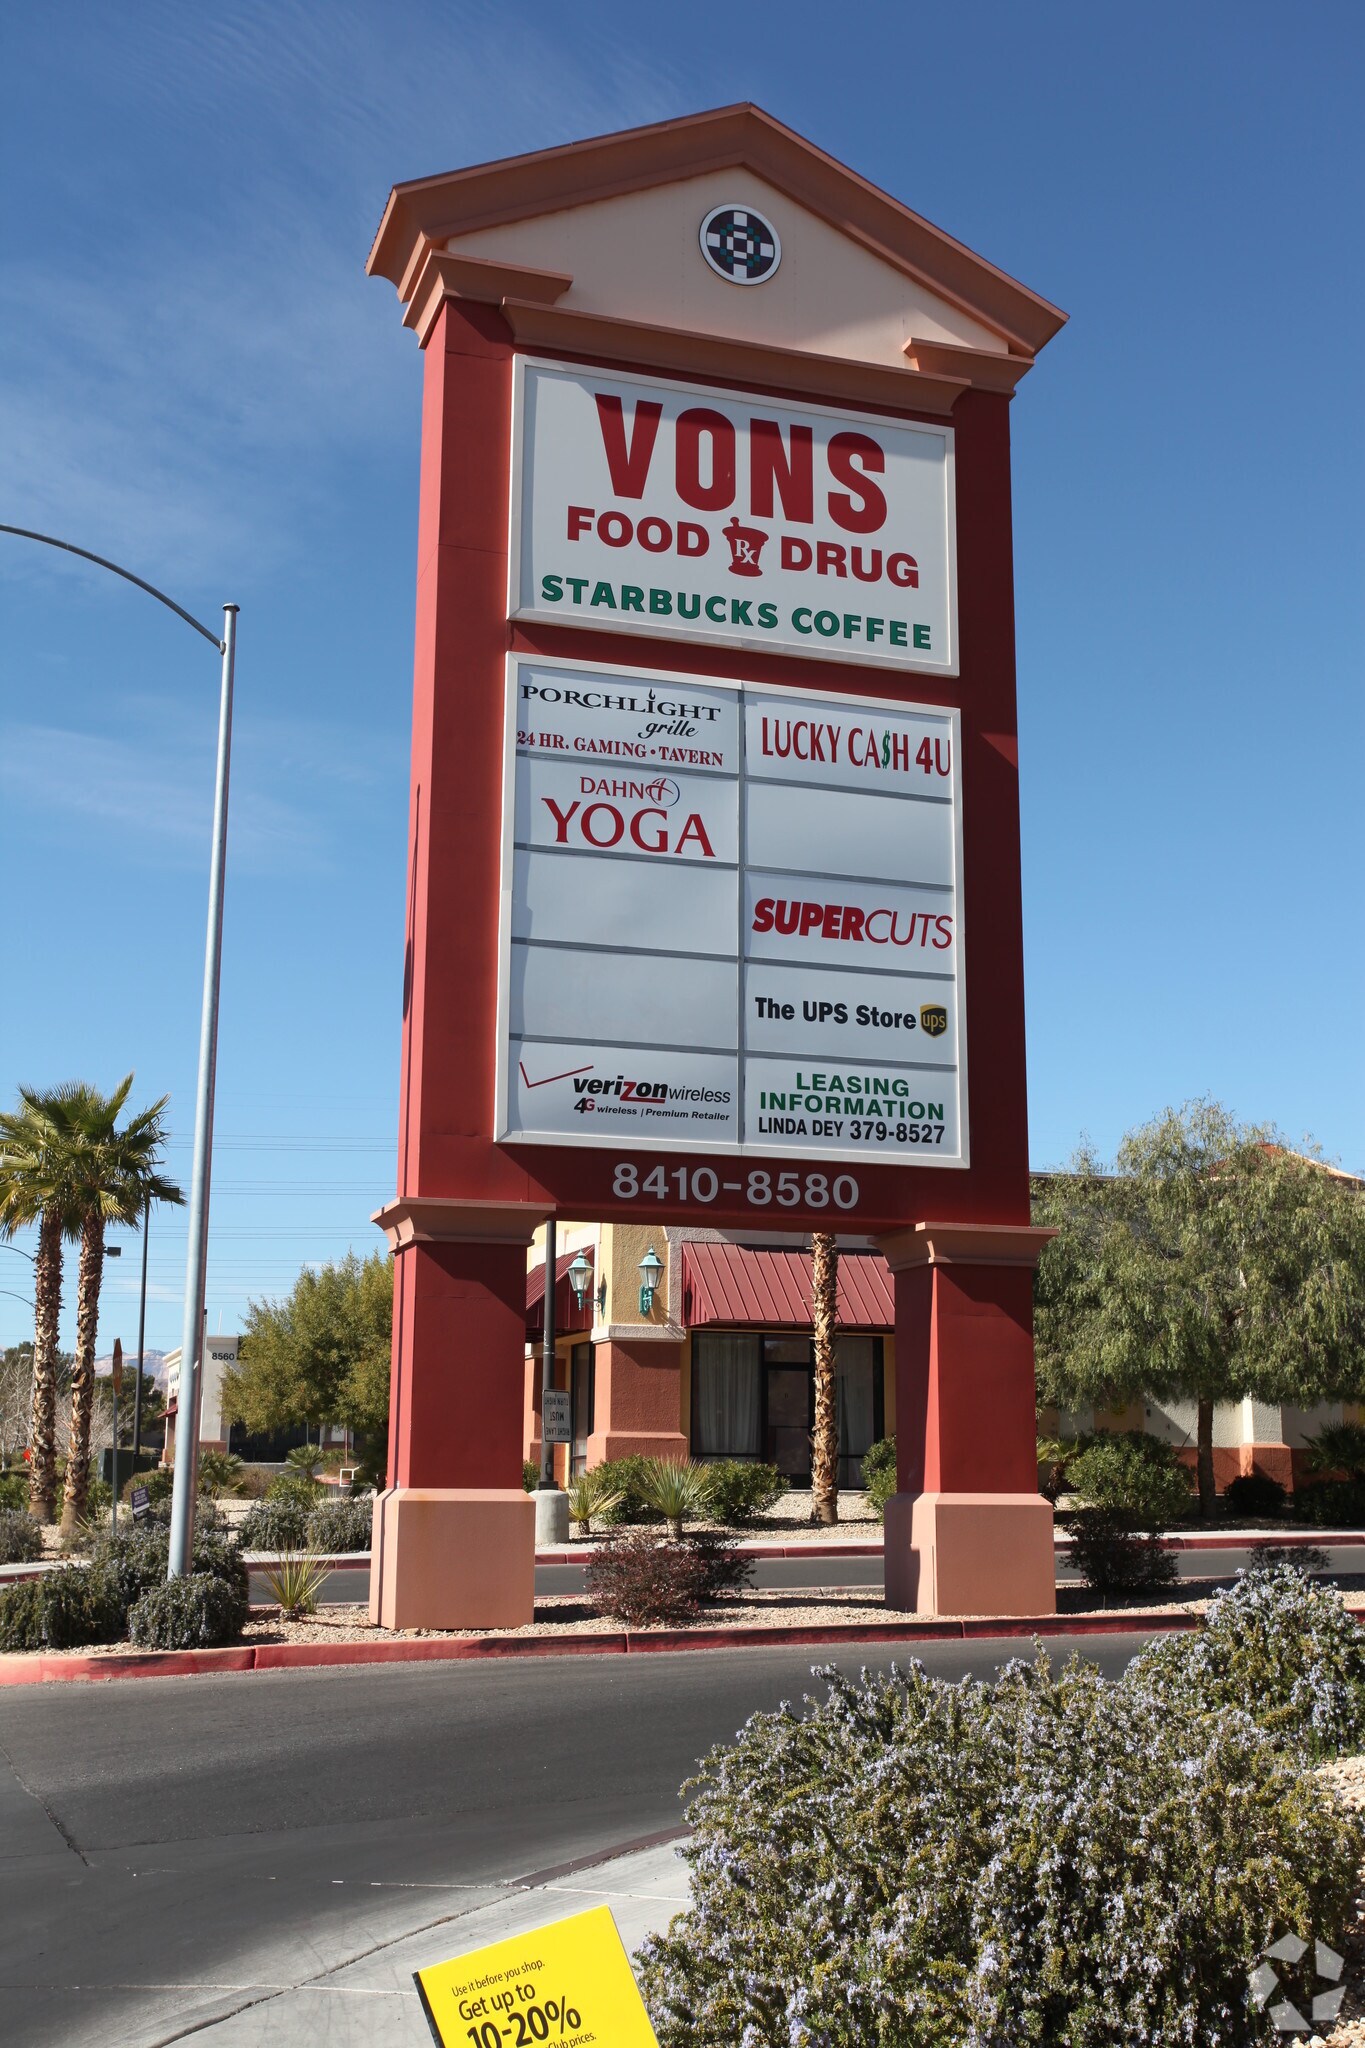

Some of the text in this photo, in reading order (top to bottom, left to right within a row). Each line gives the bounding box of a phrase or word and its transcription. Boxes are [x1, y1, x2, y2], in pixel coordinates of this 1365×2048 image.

[594, 393, 887, 534] VONS
[567, 505, 710, 558] FOOD
[780, 536, 919, 589] DRUG
[541, 574, 932, 650] STARBUCKS COFFEE
[521, 685, 721, 722] PORCHLIGHT
[637, 719, 699, 739] grille
[762, 717, 951, 777] LUCKY CA$H 4U
[517, 730, 723, 767] 24 HR. GAMING TAVERN
[580, 776, 644, 800] DAHN
[541, 797, 716, 857] YOGA
[751, 897, 954, 949] SUPERCUTS
[755, 997, 917, 1030] The UPS Store
[922, 1014, 946, 1032] ups
[796, 1072, 909, 1097] LEASING
[573, 1097, 730, 1121] 4G wireless Premium Retailer
[760, 1091, 944, 1121] INFORMATION
[758, 1117, 945, 1144] LINDA DEY 379-8527
[611, 1162, 860, 1210] 8410-8580
[211, 1352, 235, 1361] 8560
[549, 1411, 565, 1422] MUST
[451, 1959, 545, 1997] Use it before you shop.
[458, 1983, 536, 2021] Get up to
[467, 1996, 582, 2048] 10-20%
[569, 2032, 597, 2048] prices.
